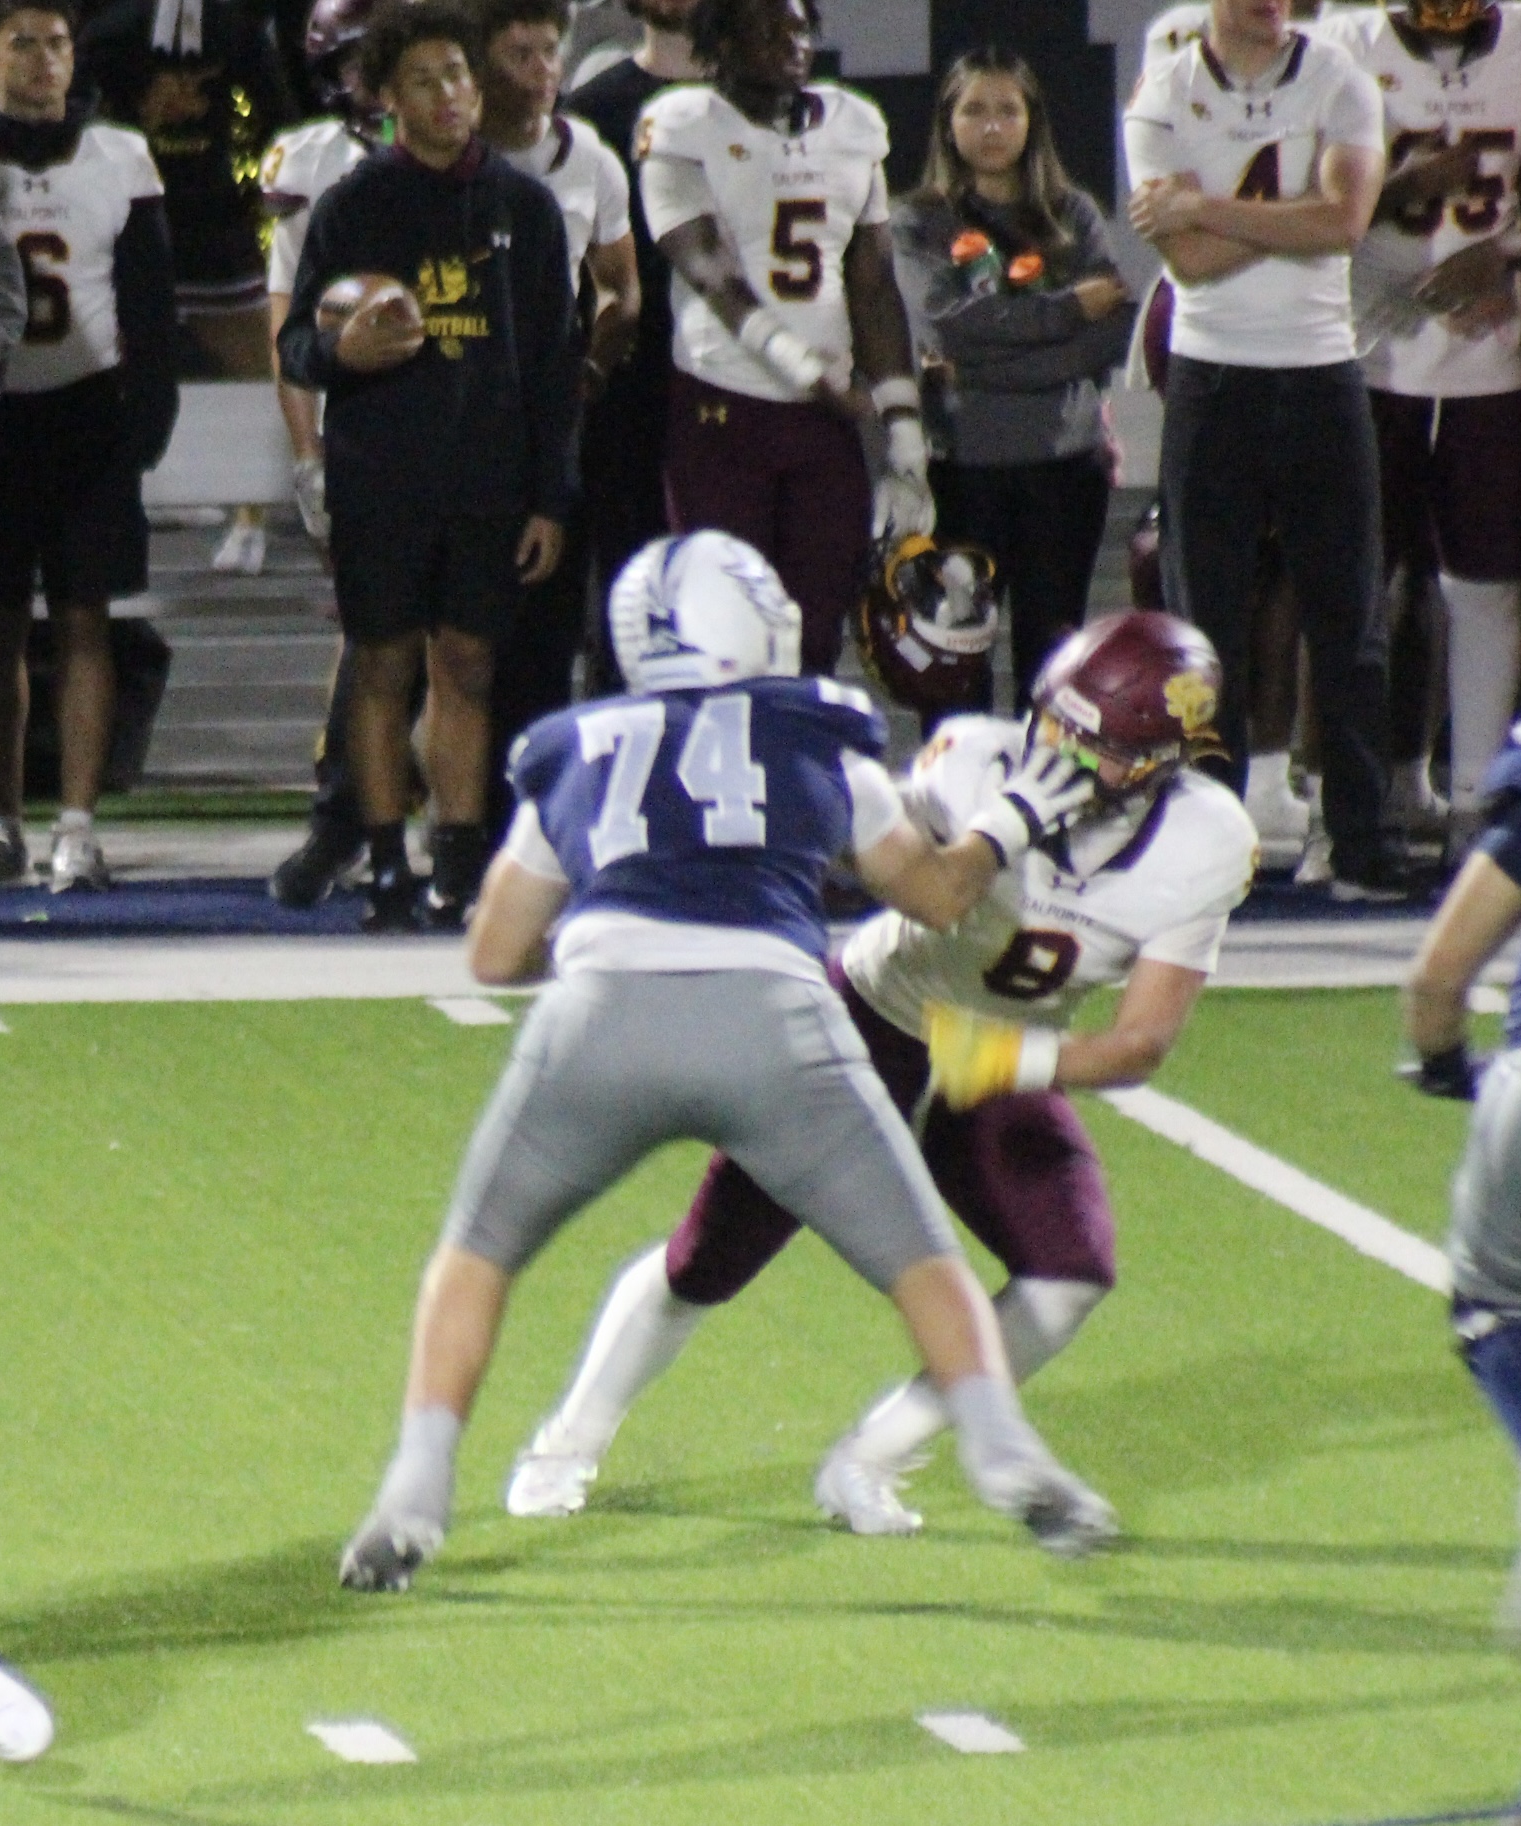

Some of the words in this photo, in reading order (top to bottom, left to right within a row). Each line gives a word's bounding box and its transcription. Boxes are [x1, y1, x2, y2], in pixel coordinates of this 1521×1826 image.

[16, 231, 70, 345] 6
[768, 199, 828, 301] 5
[576, 692, 768, 873] 74
[982, 927, 1081, 1000] 8
